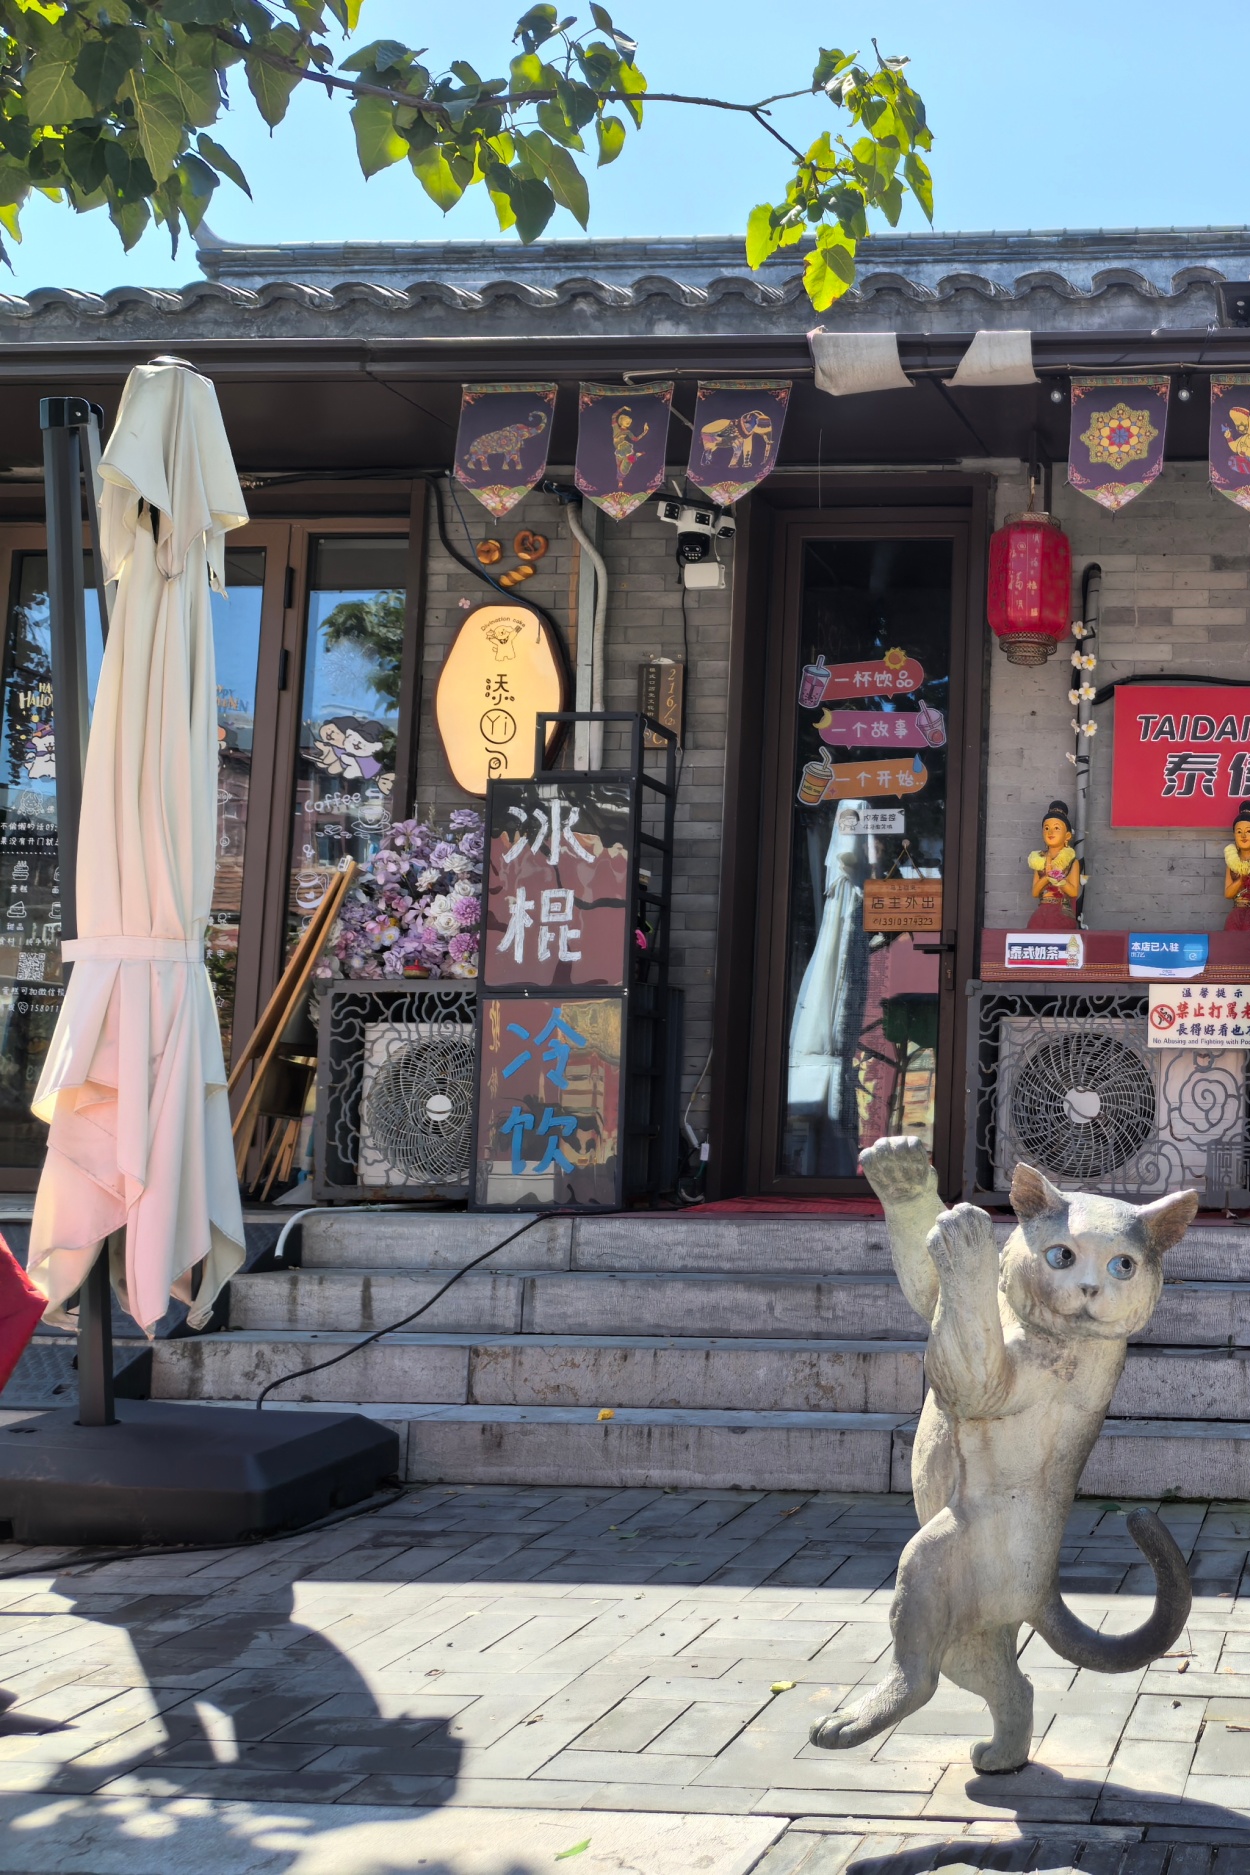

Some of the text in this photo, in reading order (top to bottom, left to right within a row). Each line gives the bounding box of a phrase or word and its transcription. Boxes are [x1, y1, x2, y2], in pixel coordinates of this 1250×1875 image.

[480, 617, 510, 631] Divination
[834, 670, 914, 688] 一杯饮品
[18, 690, 54, 709] HALLO
[831, 719, 909, 739] 一个故事
[497, 798, 597, 965] 冰棍
[871, 896, 934, 909] 店主外出
[1009, 945, 1060, 960] 泰式奶茶
[1131, 941, 1180, 952] 本店已入驻
[499, 1007, 588, 1176] 冷饮
